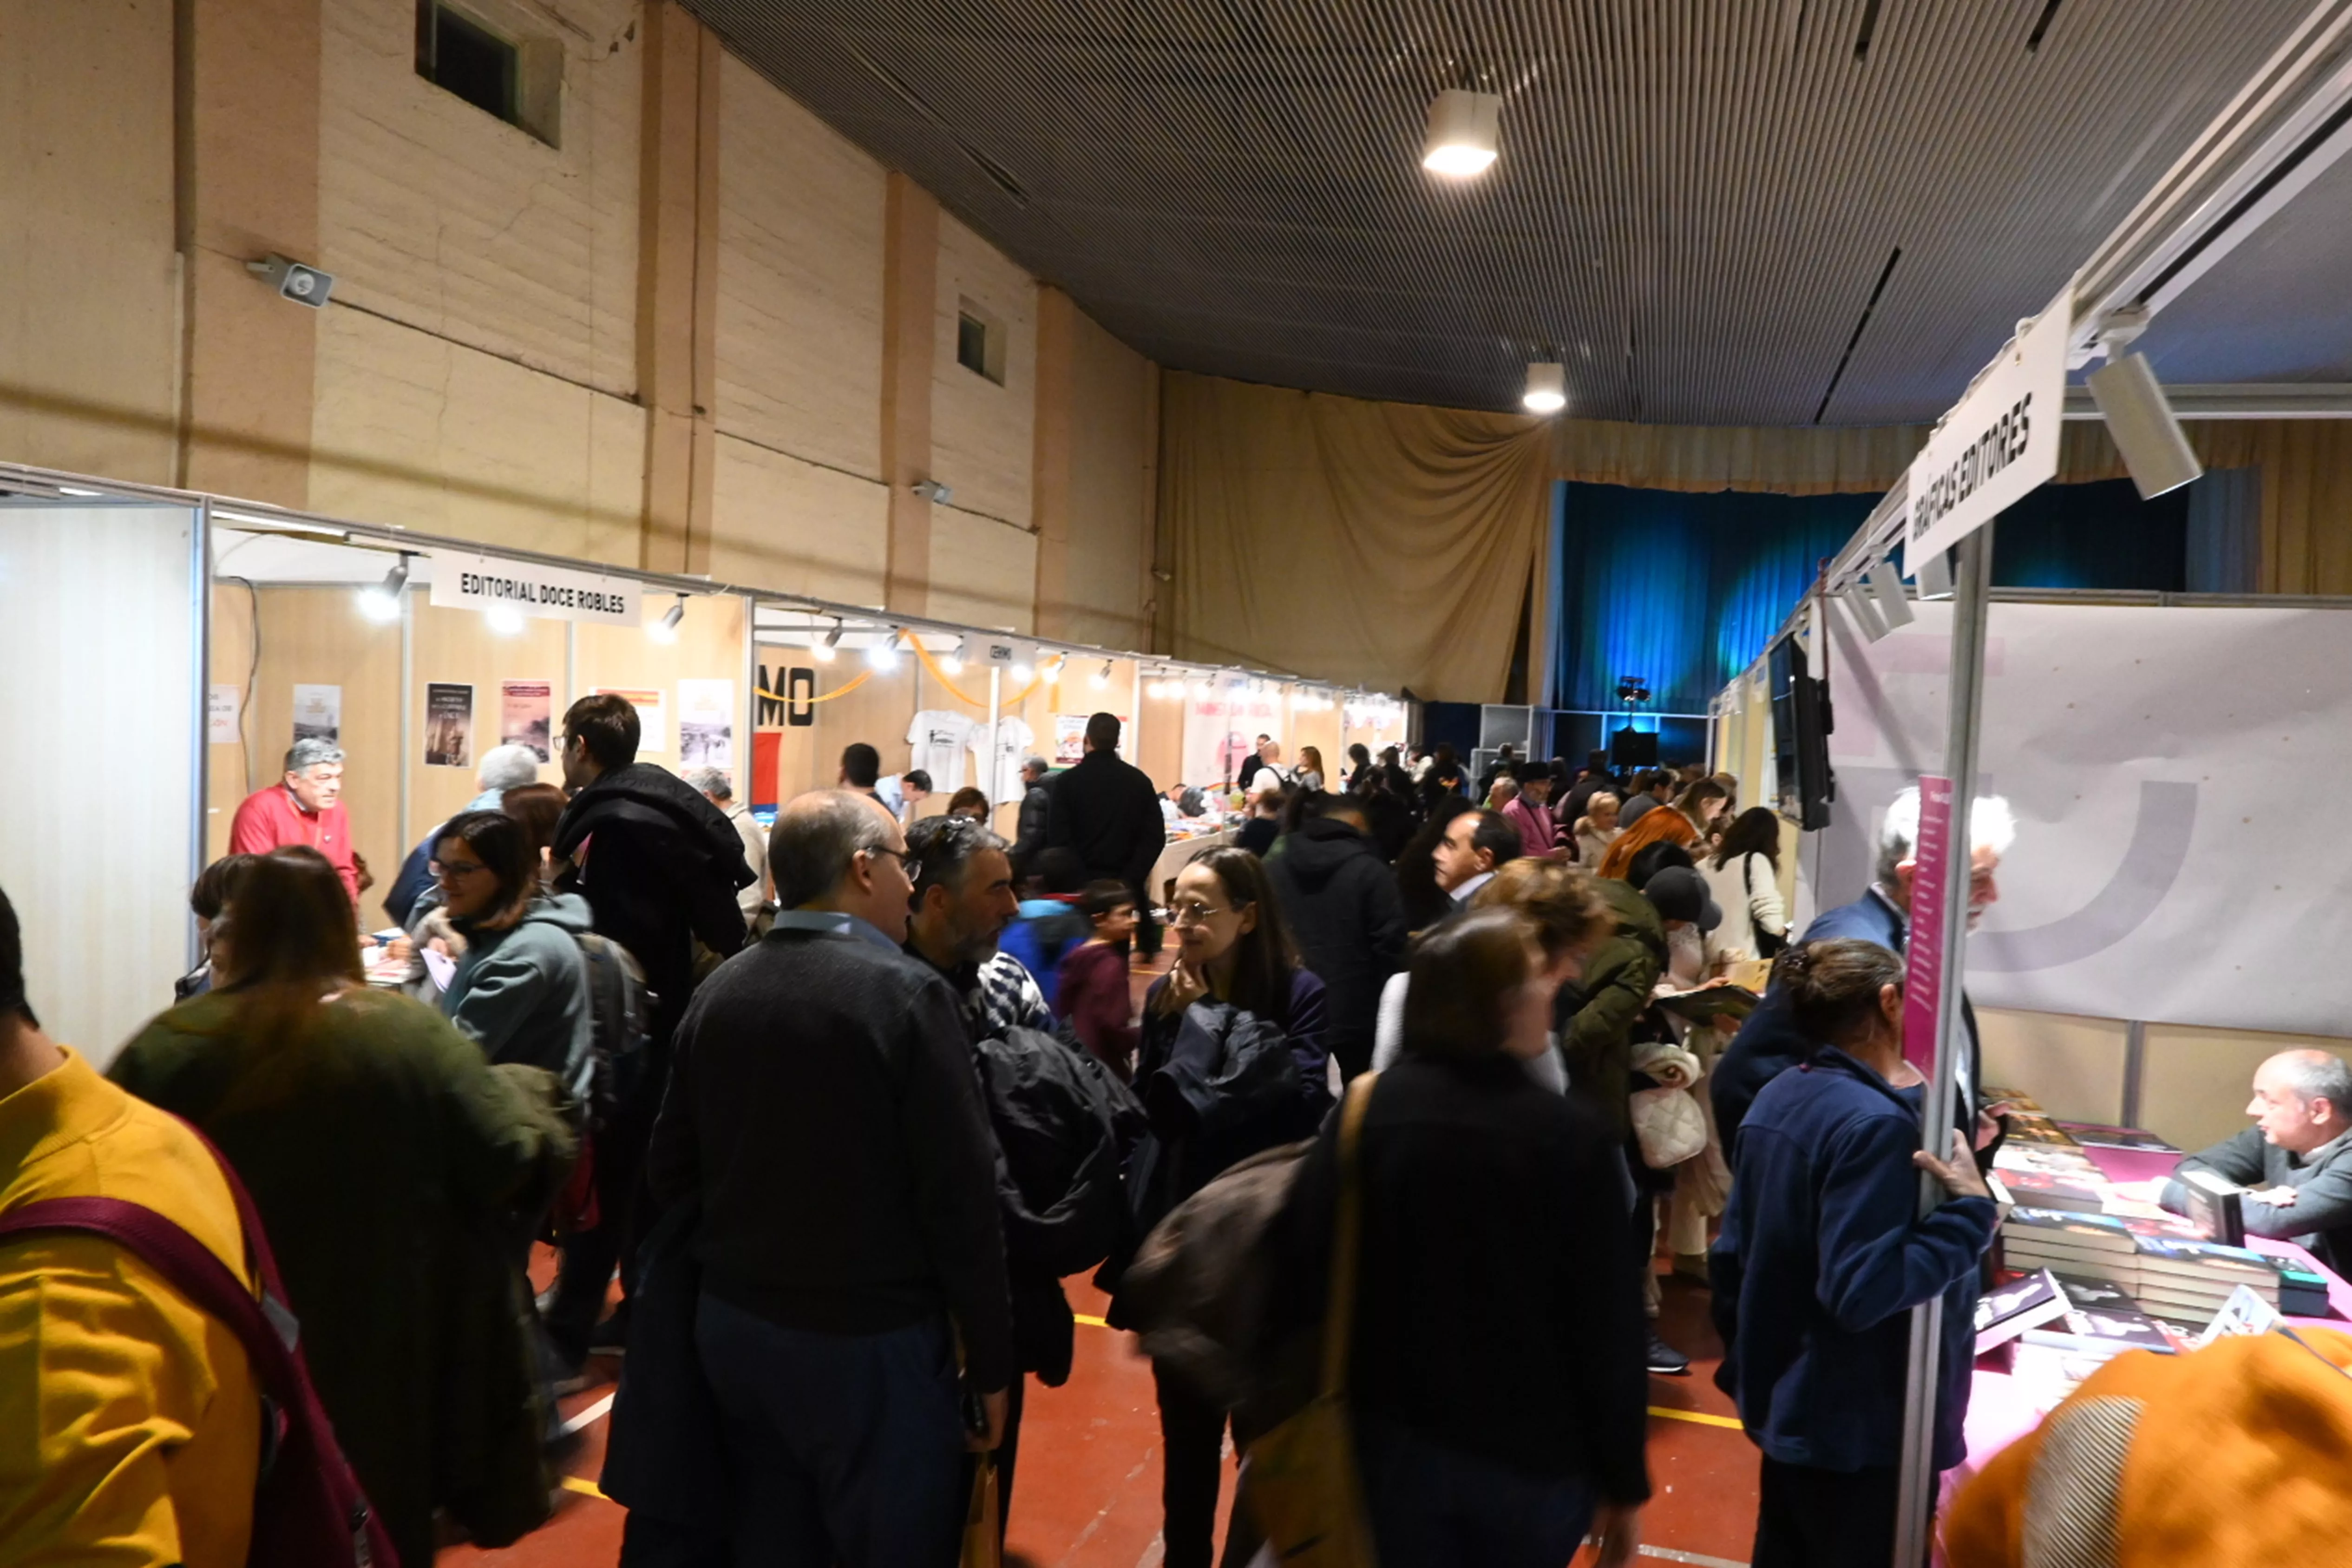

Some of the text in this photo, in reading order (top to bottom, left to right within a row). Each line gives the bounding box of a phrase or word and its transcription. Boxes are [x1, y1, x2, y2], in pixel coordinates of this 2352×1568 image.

[1959, 391, 2032, 504] EDITORES
[461, 572, 625, 614] EDITORIAL DOCE ROBLES
[758, 664, 814, 726] MO
